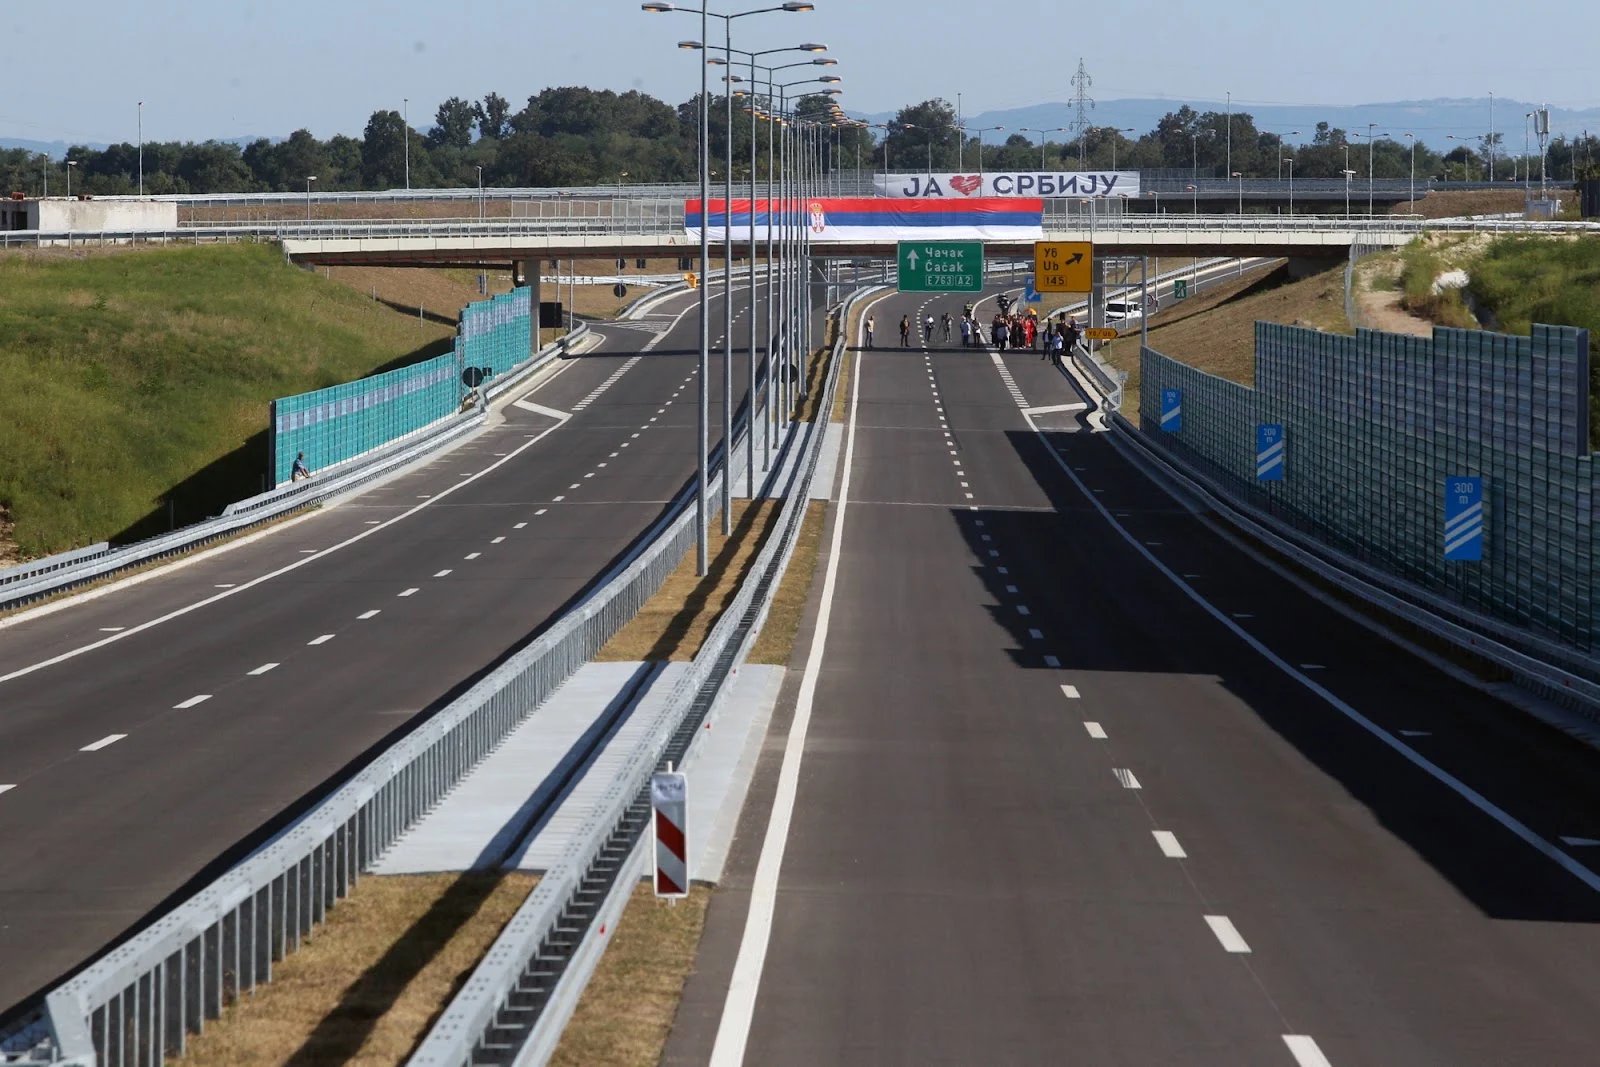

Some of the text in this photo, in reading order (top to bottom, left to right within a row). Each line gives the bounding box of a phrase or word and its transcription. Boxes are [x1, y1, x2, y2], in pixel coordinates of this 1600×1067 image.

[903, 175, 1118, 197] ЈА СРБИЈУ
[925, 247, 964, 258] Чачак
[1043, 248, 1058, 258] Уб
[925, 259, 964, 272] Čačak
[1043, 261, 1059, 271] Ub
[927, 276, 971, 285] E763 A2
[1263, 427, 1277, 436] 200
[1454, 482, 1474, 494] 300
[1459, 495, 1469, 505] m
